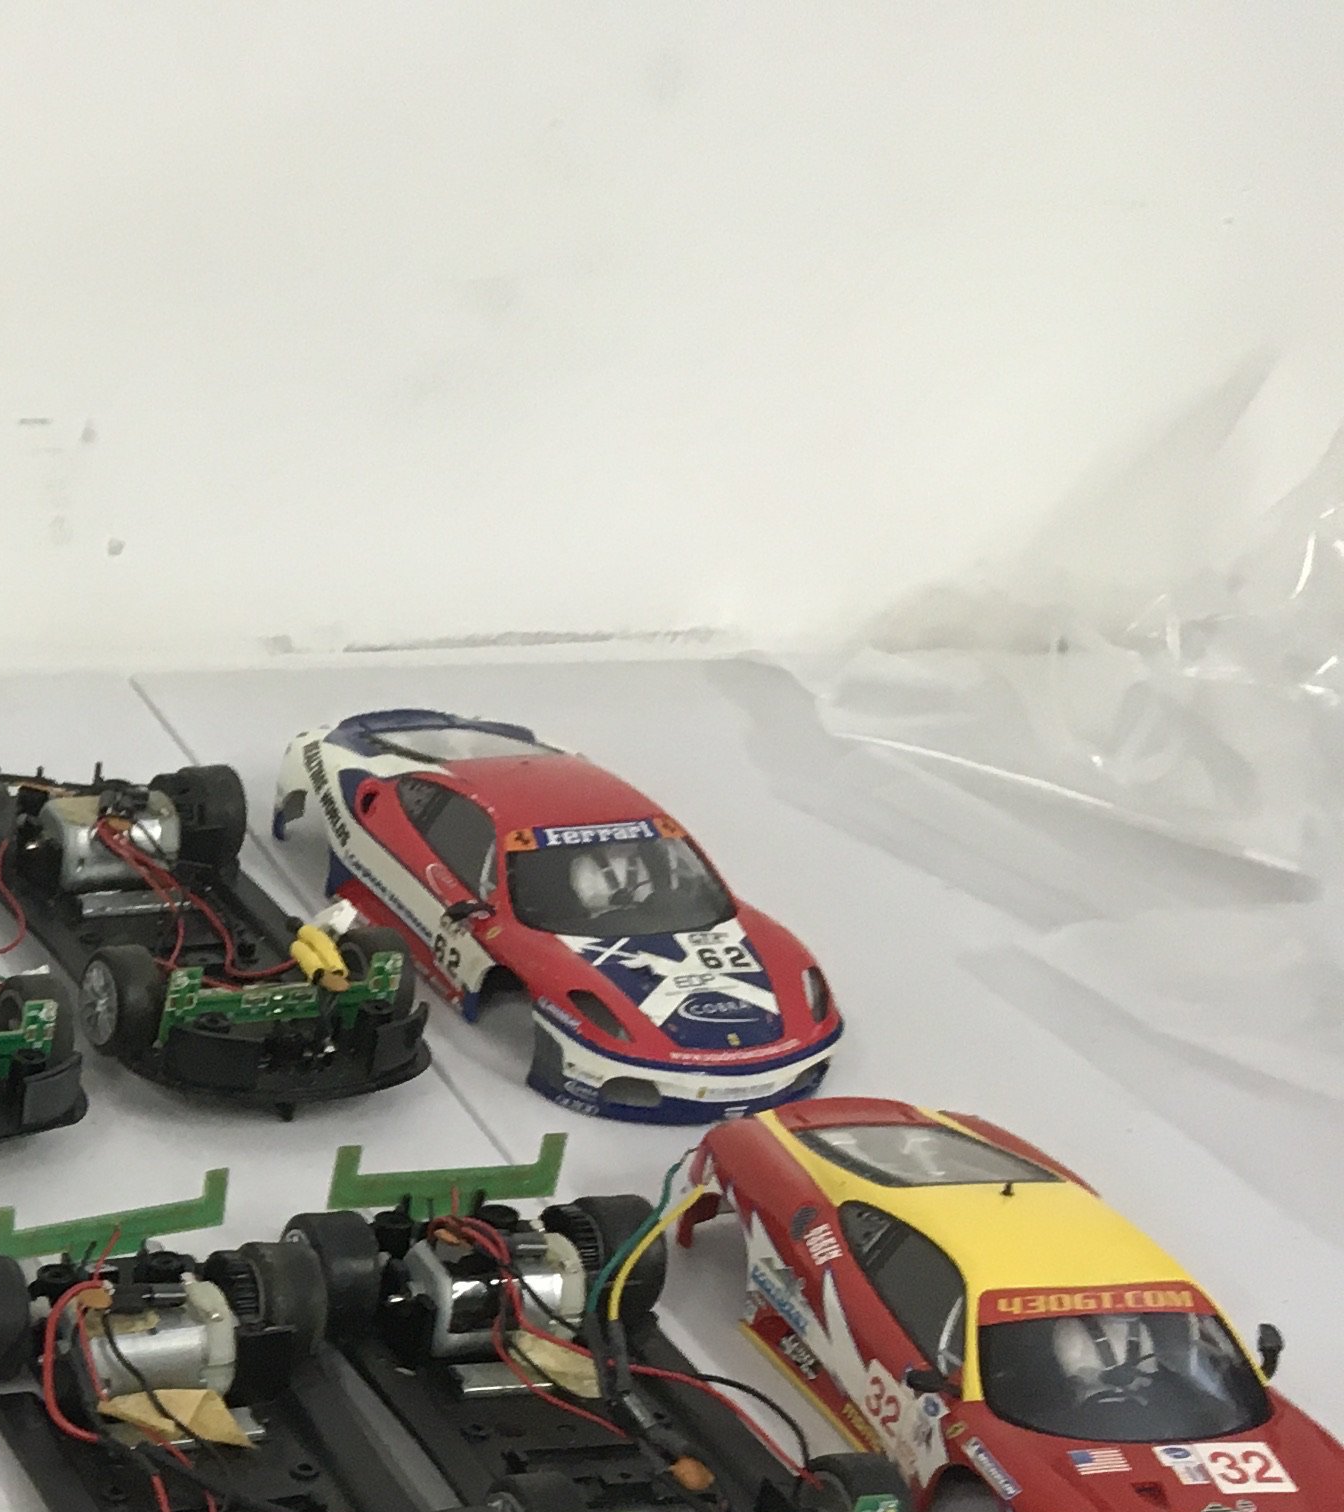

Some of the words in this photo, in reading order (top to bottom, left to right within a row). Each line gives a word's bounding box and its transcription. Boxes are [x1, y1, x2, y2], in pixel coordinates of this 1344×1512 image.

[543, 821, 654, 847] Ferrari
[697, 946, 752, 969] 62
[996, 1290, 1194, 1315] 430GT.COM
[865, 1375, 901, 1437] 32
[1208, 1450, 1283, 1485] 32
